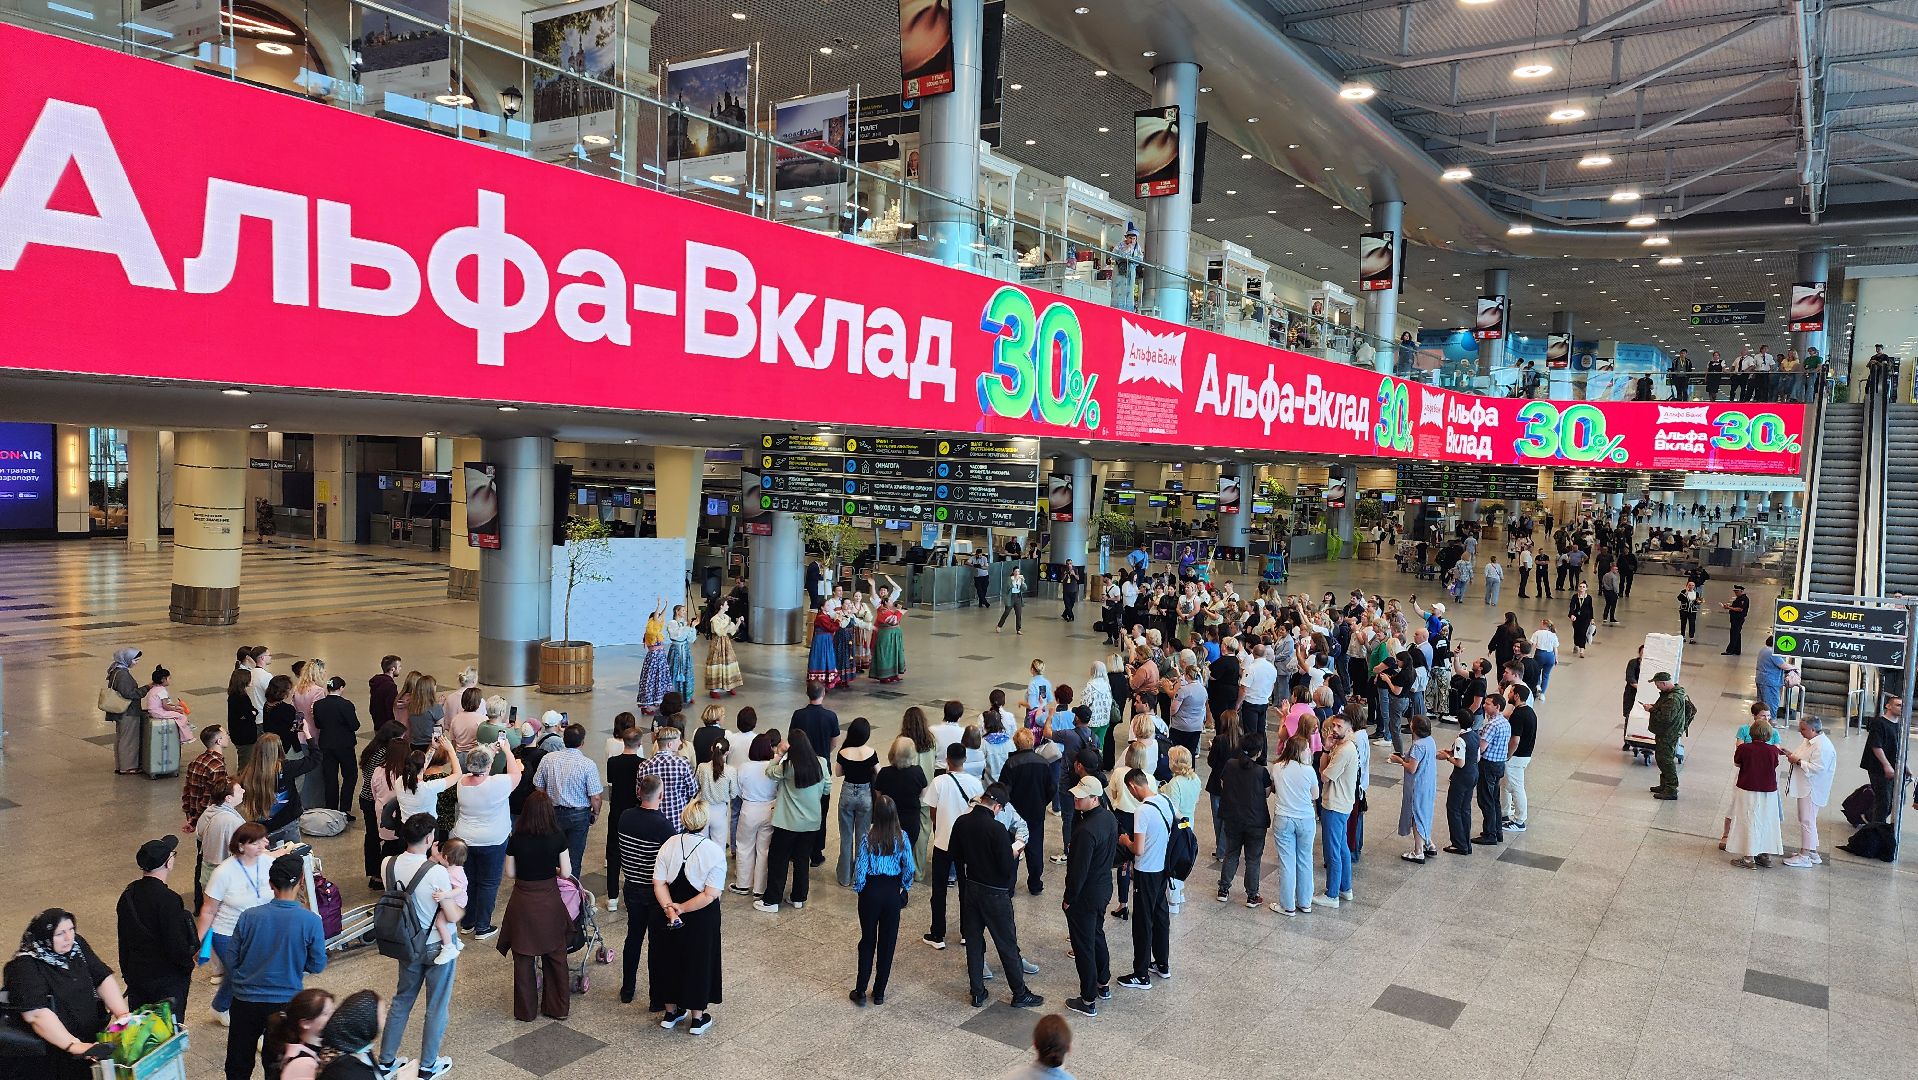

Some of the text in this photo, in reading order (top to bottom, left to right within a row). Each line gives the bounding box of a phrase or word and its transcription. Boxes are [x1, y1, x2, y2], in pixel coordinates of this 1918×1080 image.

[860, 124, 878, 132] ТУАЛЕТ
[0, 98, 956, 402] Альфа-Вклад
[977, 286, 1100, 430] 30%
[1195, 353, 1369, 440] Альфа-Вклад
[1375, 377, 1413, 452] 30%
[1447, 396, 1499, 432] Альфа
[1446, 426, 1492, 460] Вклад
[1513, 401, 1628, 463] 30%
[1655, 429, 1708, 443] Альфа
[1655, 440, 1705, 454] Вклад
[1710, 411, 1801, 454] 30%
[731, 504, 740, 513] 62
[1830, 621, 1865, 630] DEPARTURES
[1831, 610, 1865, 621] ВЫЛЕТ
[1829, 640, 1865, 651] ТУАЛЕТ
